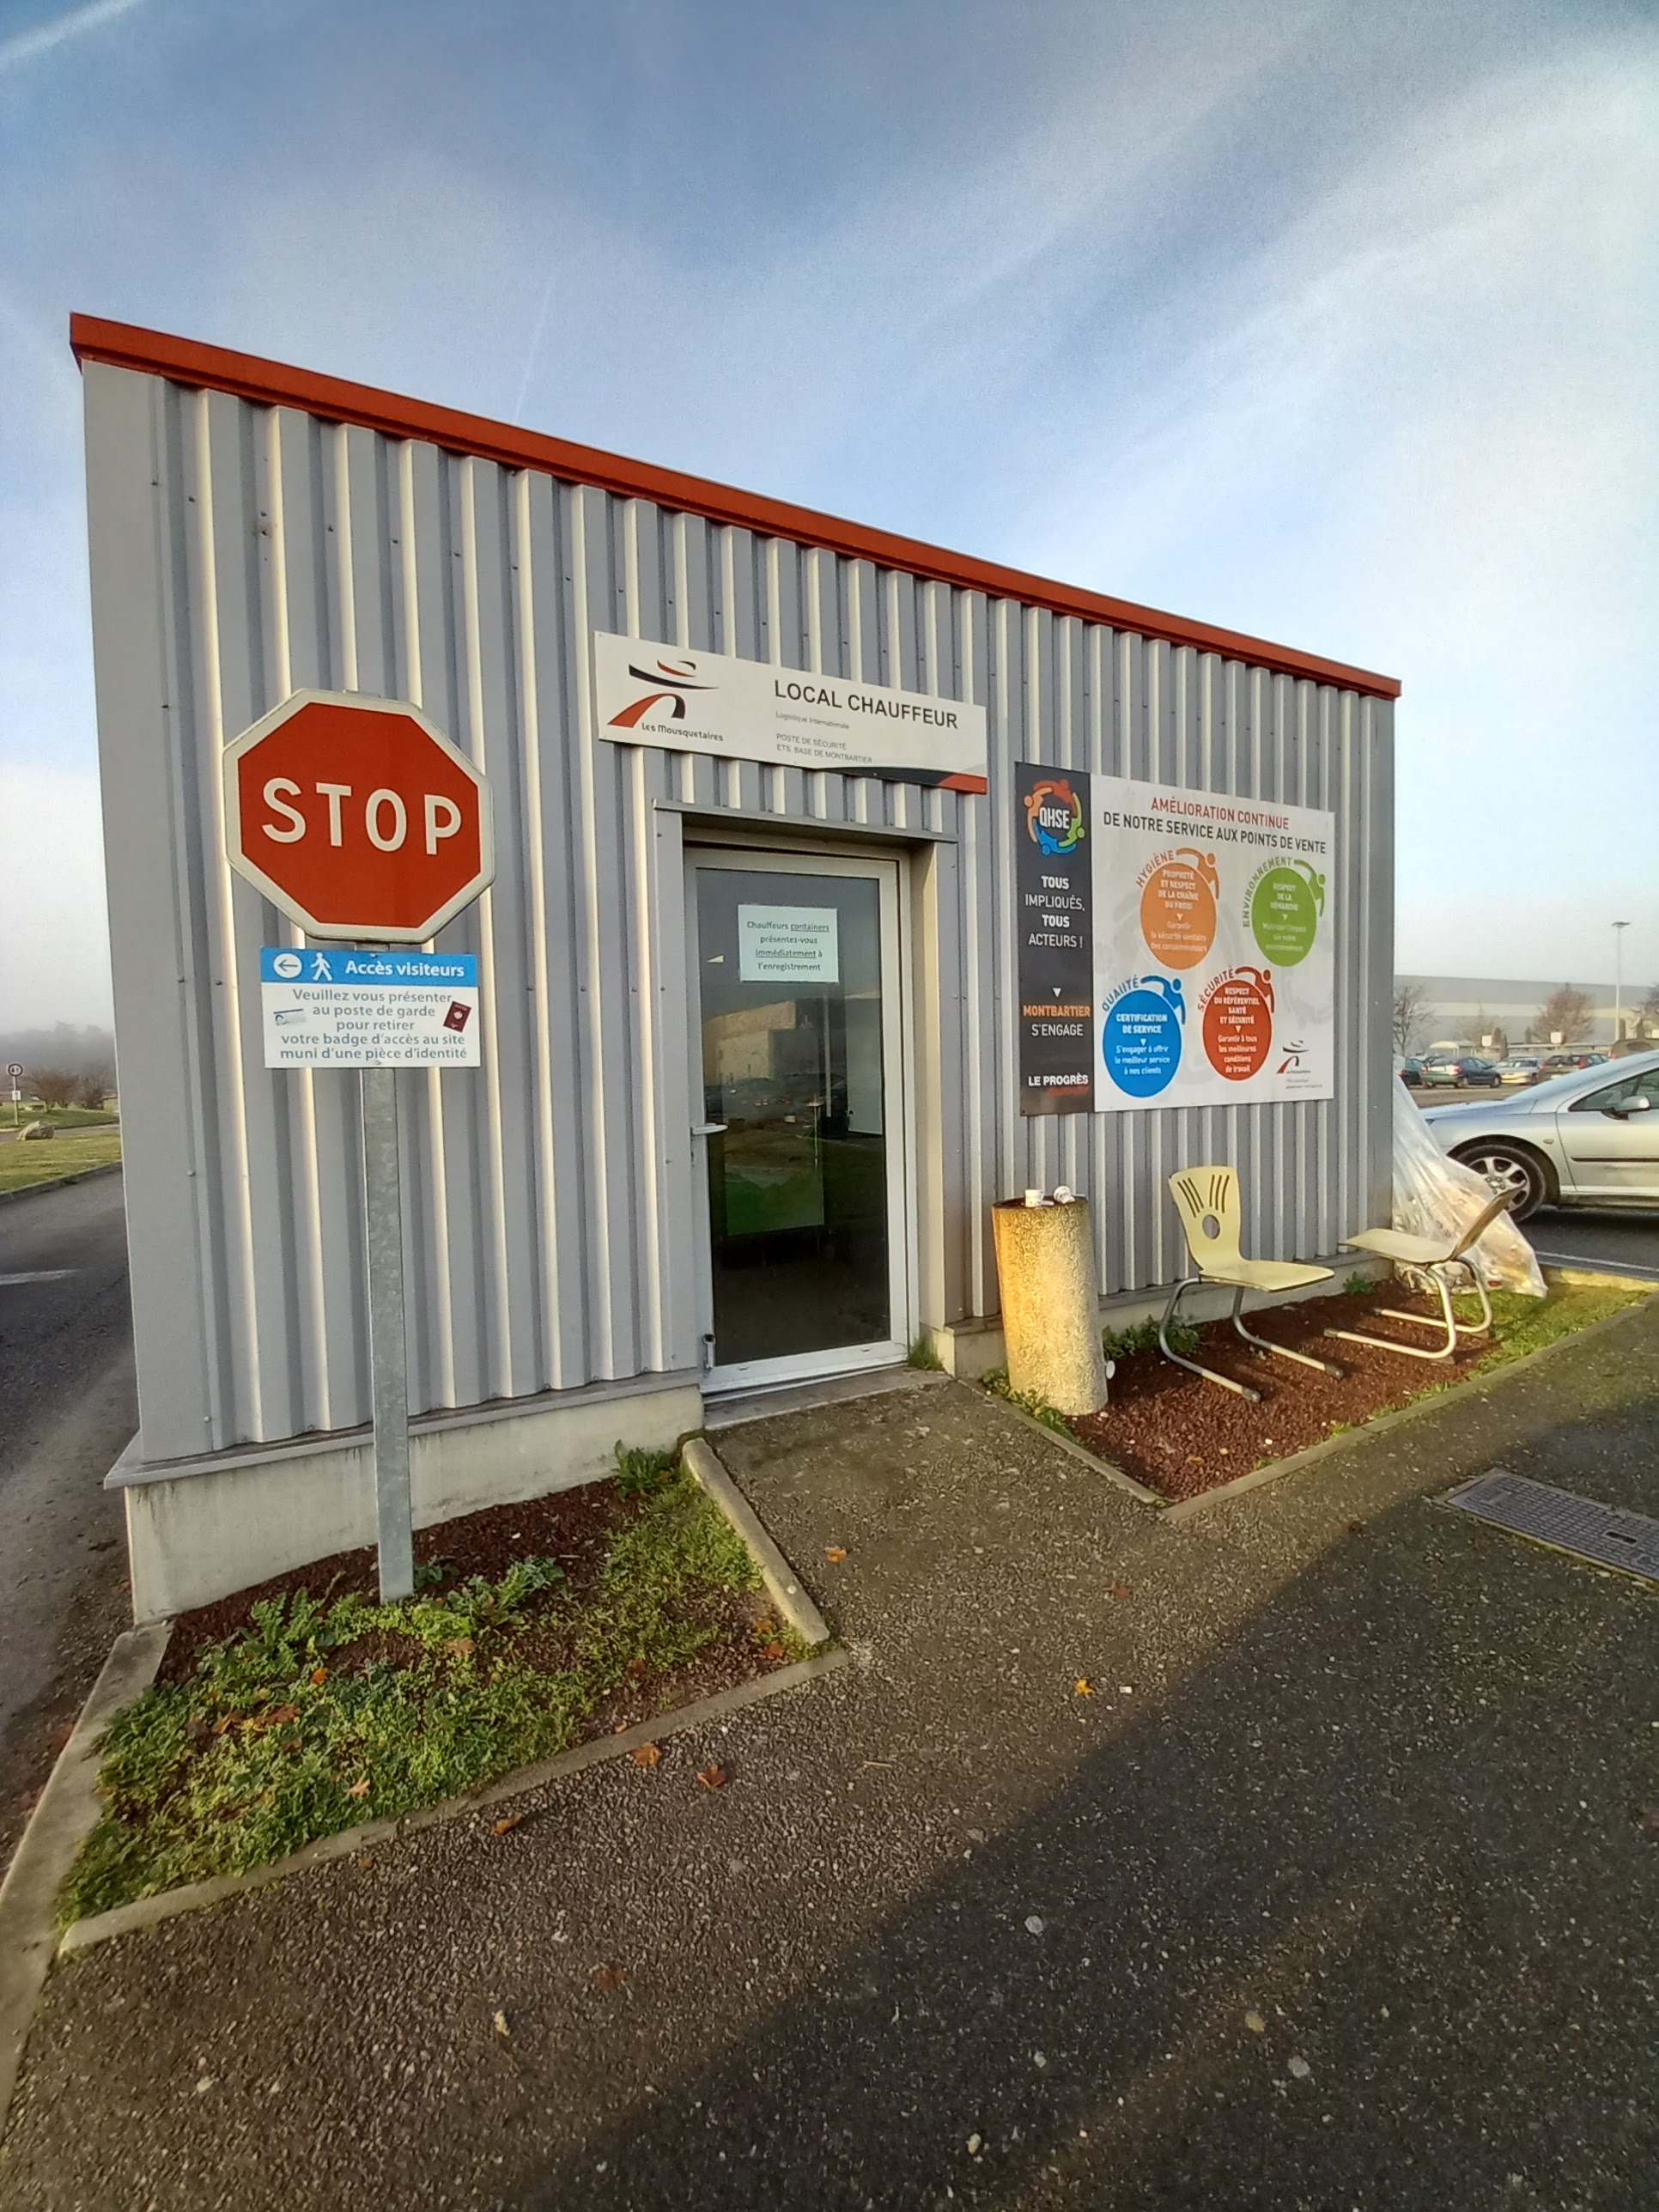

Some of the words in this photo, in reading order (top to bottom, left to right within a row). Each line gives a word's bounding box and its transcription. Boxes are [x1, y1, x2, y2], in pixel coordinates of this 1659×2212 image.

[775, 680, 842, 708] LOCAL
[848, 694, 958, 729] CHAUFFEUR
[776, 733, 799, 744] POSTE
[813, 738, 846, 750] SÉCURITÉ
[794, 746, 812, 756] BASE
[825, 751, 872, 763] MONTBARTIER
[261, 777, 462, 856] STOP
[1039, 806, 1070, 830] QHSE
[1151, 796, 1235, 823] AMÉLIORATION
[1237, 811, 1289, 830] CONTINUE
[1103, 811, 1120, 827] DE
[1123, 814, 1164, 832] NOTRE
[1166, 820, 1213, 839] SERVICE
[1216, 828, 1238, 842] AUX
[1240, 830, 1278, 848] POINTS
[1280, 836, 1293, 849] DE
[1295, 838, 1326, 854] VENTE
[1136, 850, 1175, 889] HYGIÈNE
[1041, 875, 1070, 890] TOUS
[1158, 890, 1167, 898] DE
[1168, 890, 1176, 899] LA
[1243, 856, 1292, 927] ENVIRONNEMENT
[747, 921, 789, 930] Chauffeurs
[791, 922, 830, 933] containers
[1042, 915, 1070, 928] TOUS
[760, 935, 817, 944] présentez-vous
[1028, 933, 1077, 947] ACTEURS
[756, 949, 817, 958] immédiatement
[345, 960, 392, 975] Accès
[397, 962, 465, 977] visiteurs
[757, 962, 821, 971] l'enregistrement
[1102, 974, 1139, 1012] QUALITÉ
[1197, 965, 1235, 1012] SÉCURITÉ
[293, 989, 349, 1001] Veuillez
[353, 993, 385, 1002] vous
[389, 992, 453, 1005] présenter
[313, 1007, 330, 1016] au
[334, 1007, 372, 1018] poste
[375, 1006, 393, 1017] de
[397, 1006, 435, 1019] garde
[1023, 1005, 1091, 1018] MONTBARTIER
[1115, 1014, 1168, 1023] CERTIFICATION
[337, 1021, 368, 1032] pour
[373, 1019, 415, 1030] retirer
[1031, 1024, 1084, 1036] S'ENGAGE
[1122, 1025, 1132, 1034] DE
[1133, 1024, 1163, 1034] SERVICE
[282, 1035, 319, 1045] votre
[324, 1033, 368, 1048] badge
[371, 1033, 420, 1045] d'accès
[423, 1036, 439, 1045] au
[442, 1034, 465, 1045] site
[1218, 1034, 1240, 1042] Garantir
[281, 1048, 318, 1059] muni
[322, 1048, 362, 1059] d'une
[366, 1048, 402, 1060] pièce
[404, 1047, 467, 1059] d'identité
[1141, 1066, 1162, 1075] clients
[1028, 1075, 1041, 1087] LE
[1043, 1072, 1089, 1086] PROGRÈS
